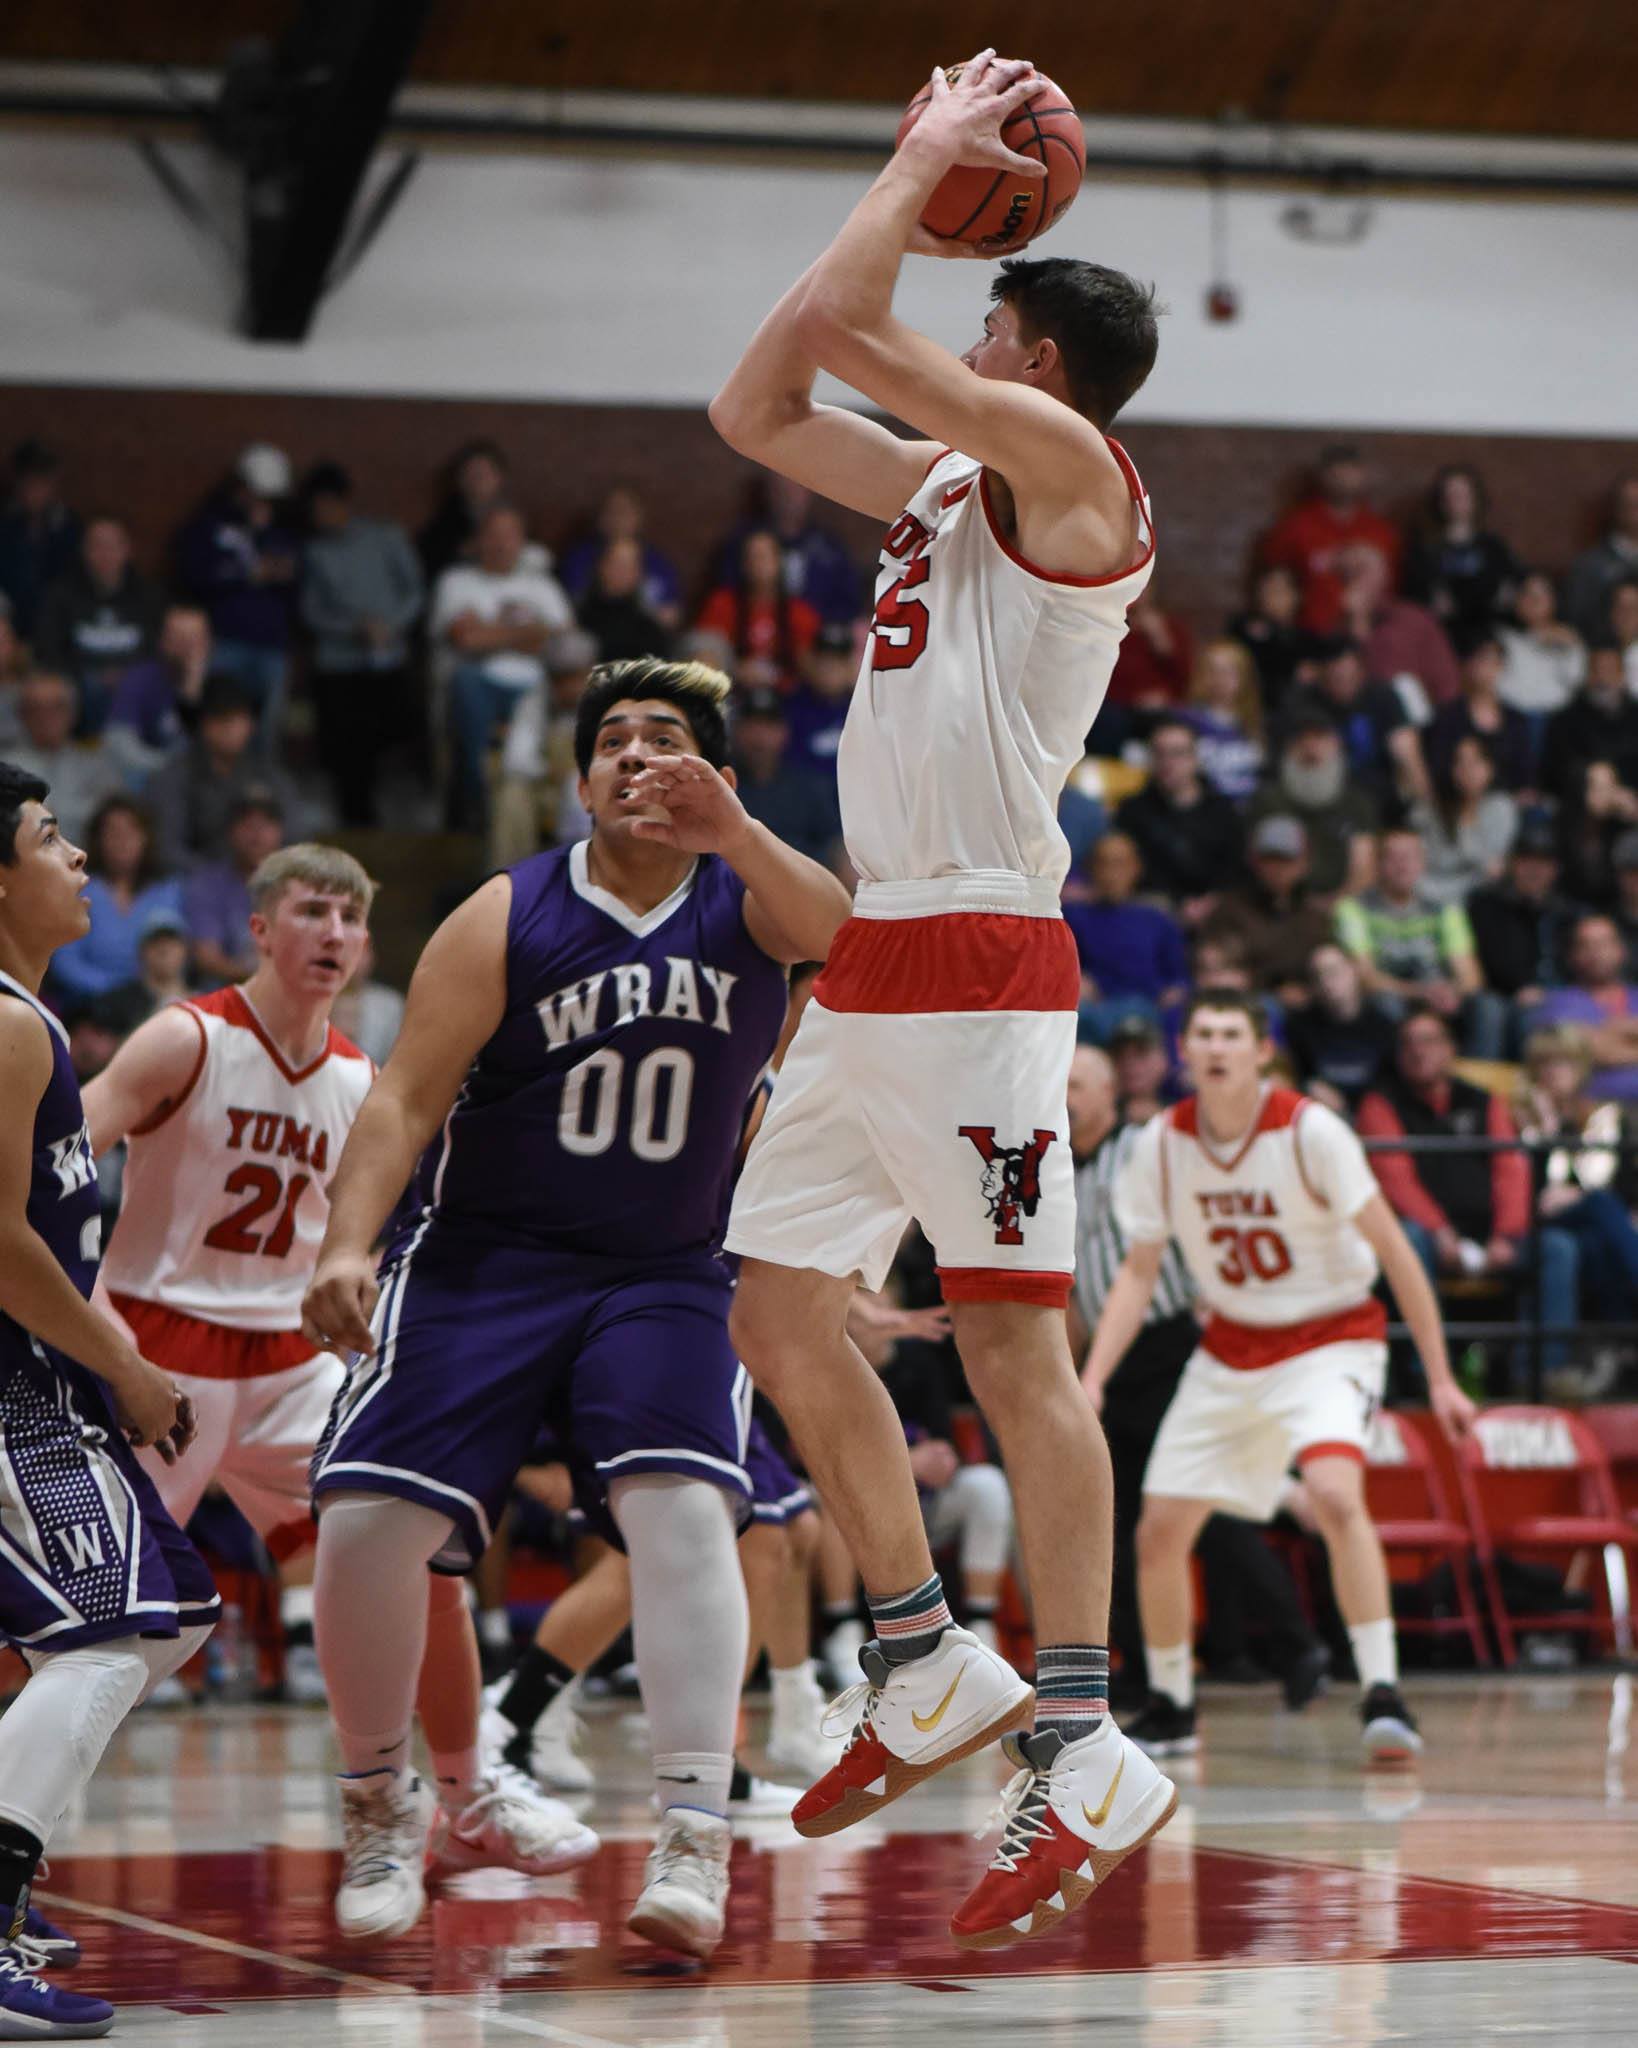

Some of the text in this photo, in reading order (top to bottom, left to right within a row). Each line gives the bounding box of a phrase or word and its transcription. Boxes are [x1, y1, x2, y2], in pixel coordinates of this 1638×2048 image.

[868, 554, 931, 672] 5
[534, 956, 740, 1052] WRAY
[226, 1106, 329, 1173] YUMA
[558, 1046, 695, 1162] 00
[203, 1161, 310, 1260] 21
[1208, 1226, 1294, 1287] 30
[54, 1521, 105, 1573] W
